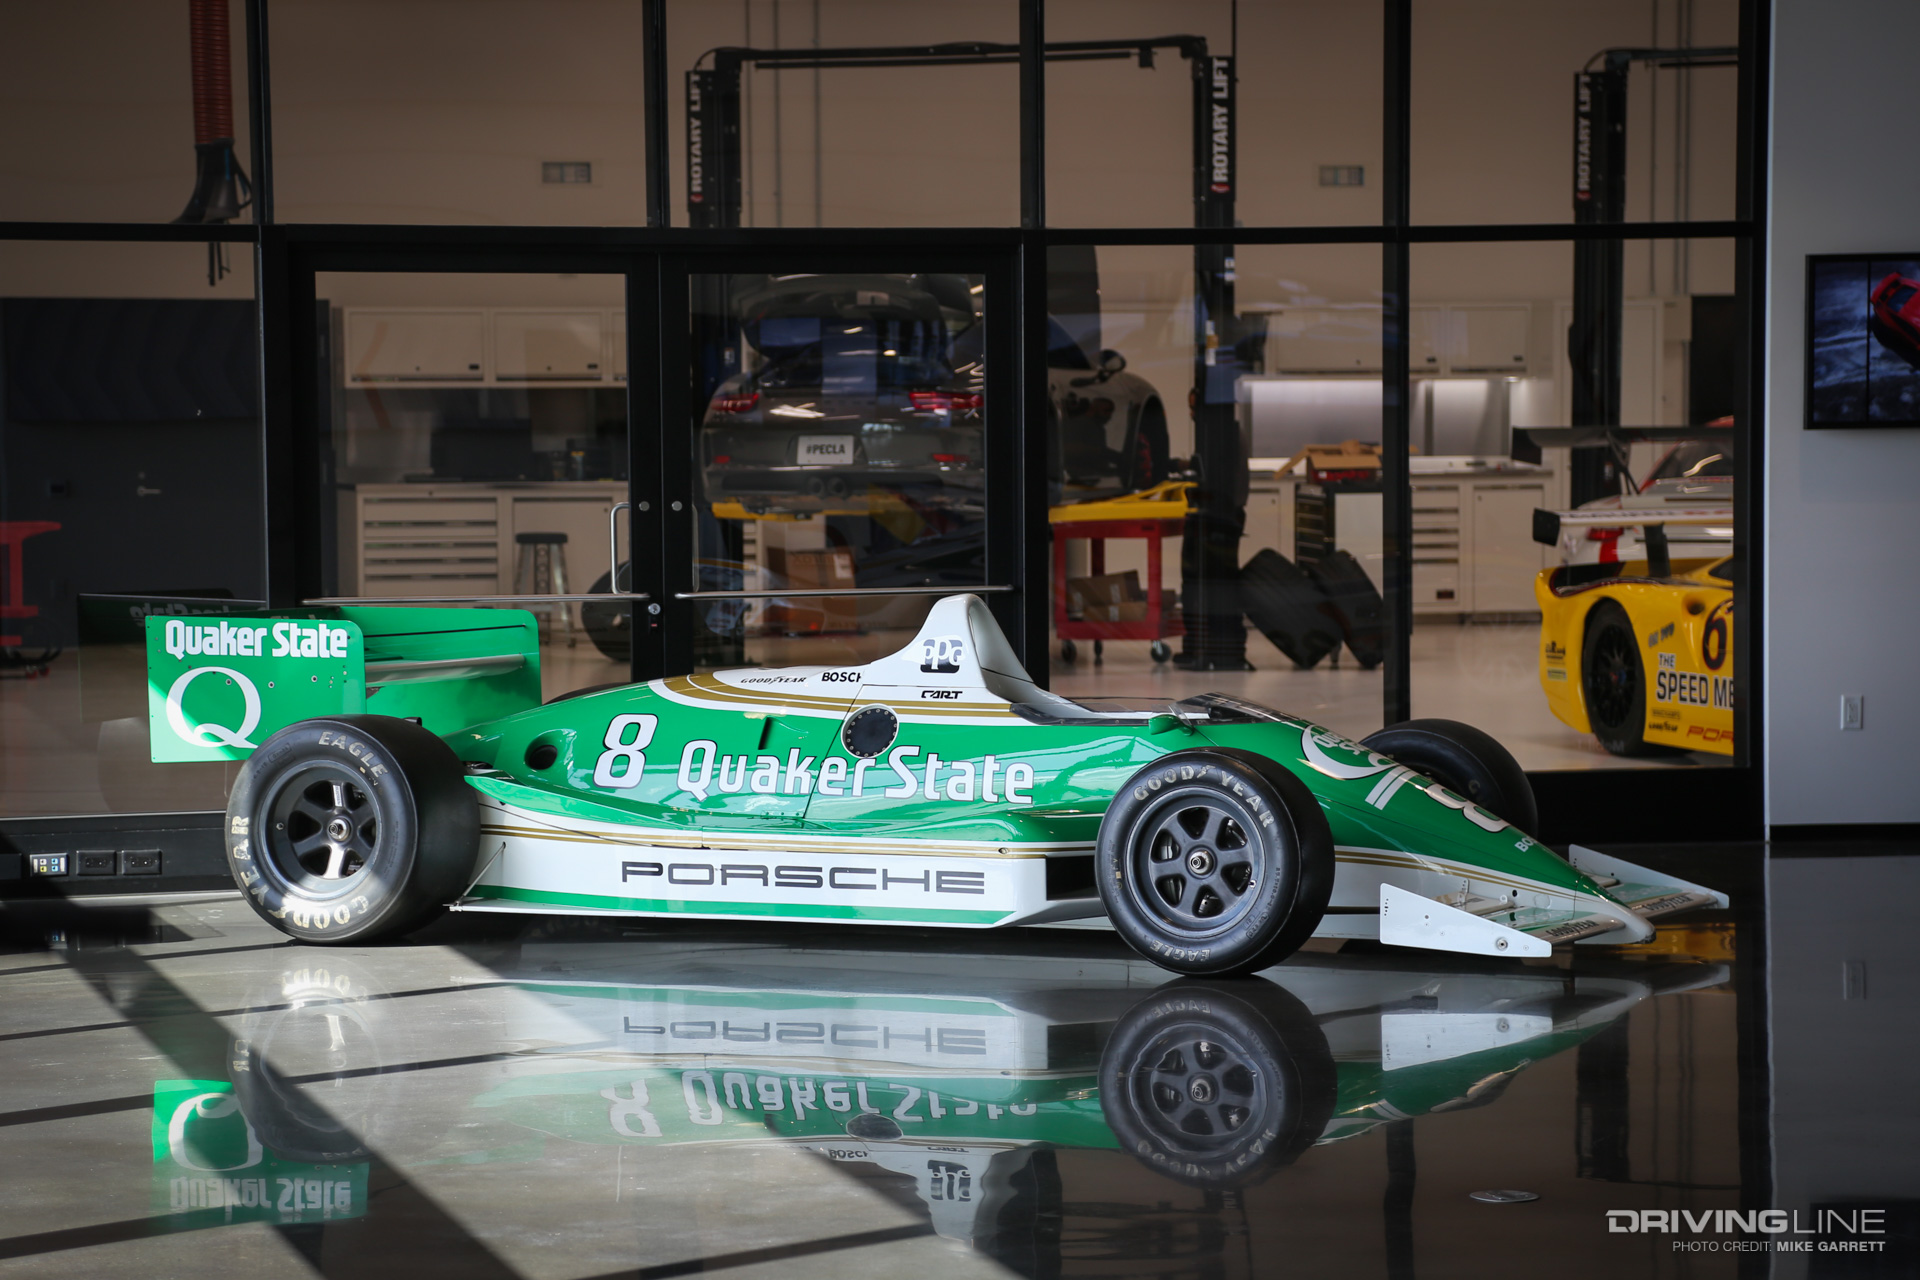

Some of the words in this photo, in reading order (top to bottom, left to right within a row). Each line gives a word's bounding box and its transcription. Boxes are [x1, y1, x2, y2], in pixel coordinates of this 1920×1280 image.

[690, 73, 702, 112] LIFT
[1212, 56, 1229, 99] LIFT
[1578, 74, 1592, 113] LIFT
[690, 116, 703, 193] ROTARY
[1212, 103, 1229, 183] ROTARY
[1577, 116, 1591, 191] ROTARY
[806, 443, 846, 455] #PECLA
[165, 620, 268, 660] Quaker
[271, 622, 348, 659] State
[1657, 652, 1676, 669] THE
[165, 666, 262, 749] Q
[921, 690, 963, 700] CART
[1656, 669, 1710, 707] SPEED
[318, 730, 389, 778] EAGLE
[592, 713, 659, 789] 8
[676, 739, 878, 802] Quaker
[884, 745, 1034, 805] State
[621, 861, 985, 895] PORSCHE
[1149, 939, 1211, 962] EAGLE
